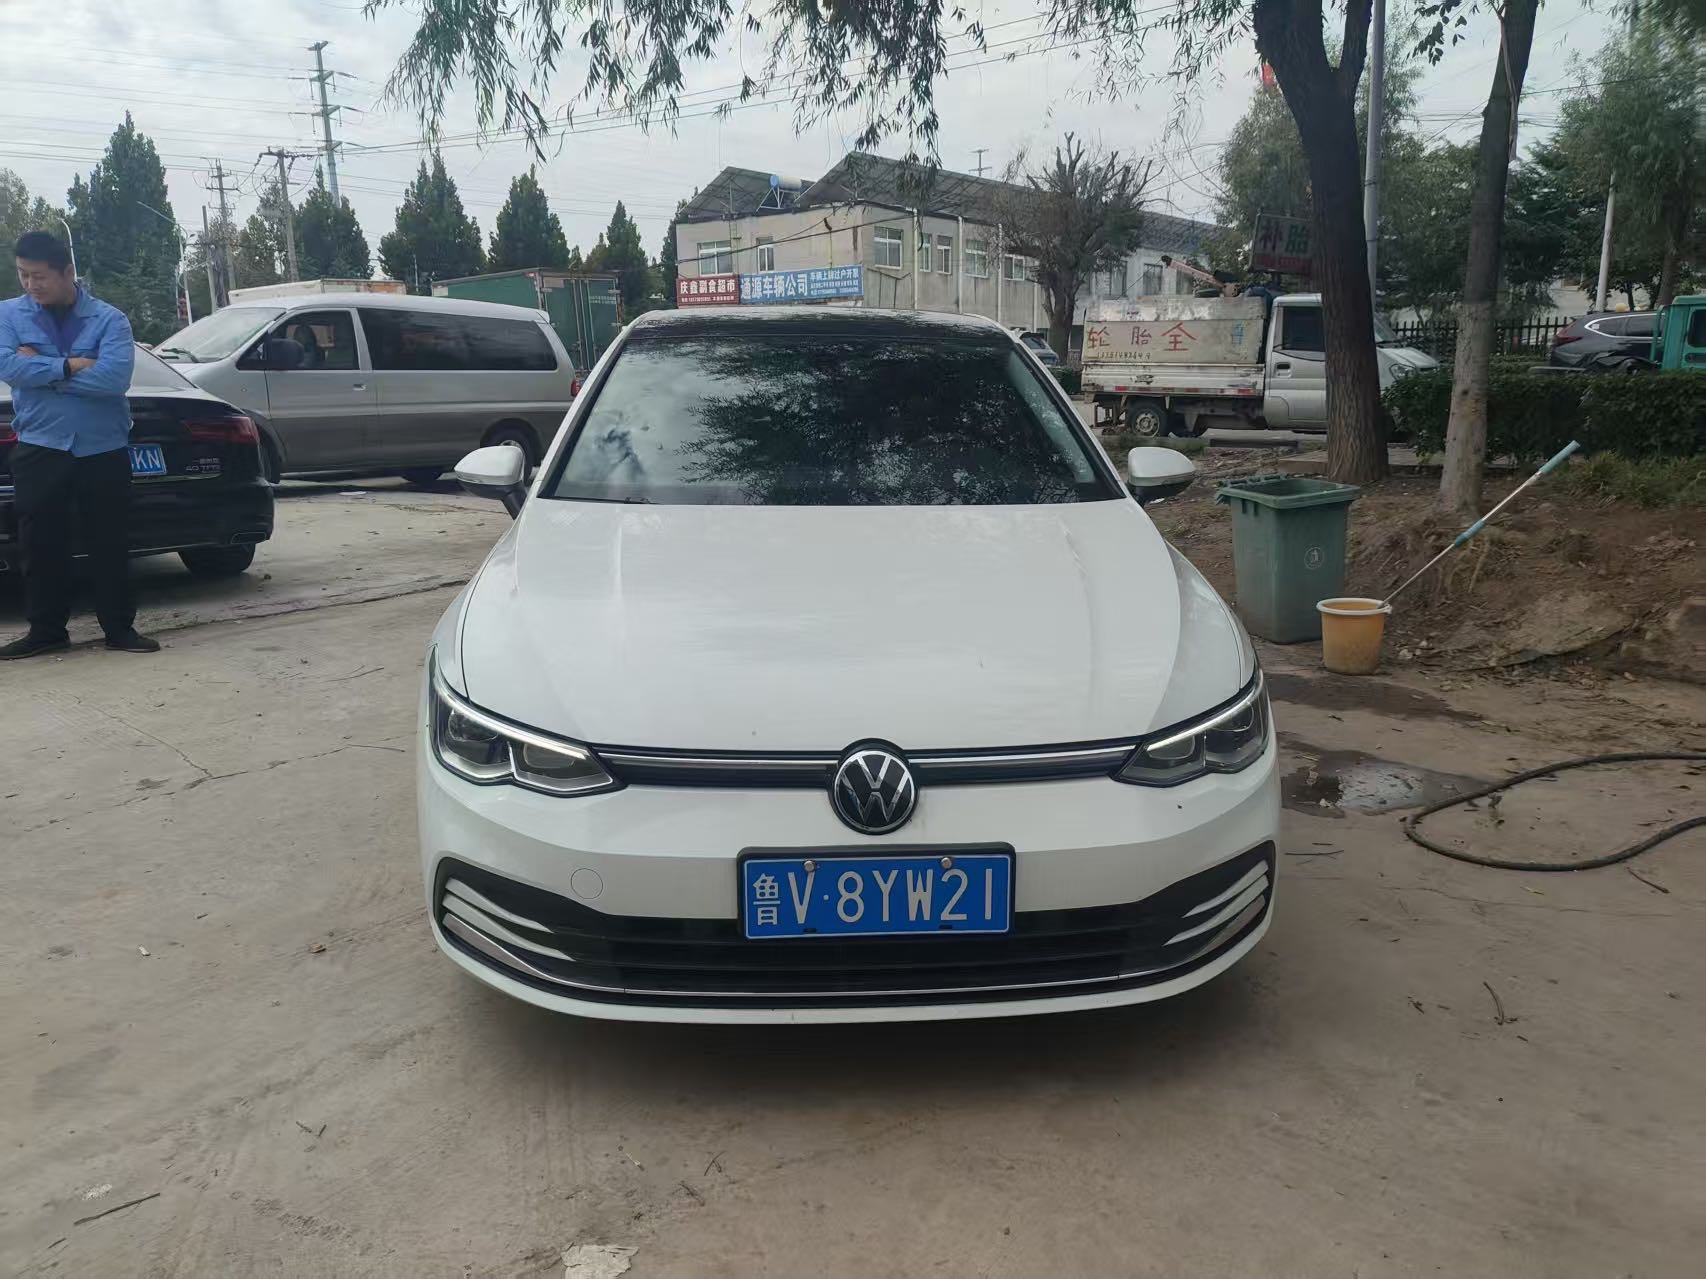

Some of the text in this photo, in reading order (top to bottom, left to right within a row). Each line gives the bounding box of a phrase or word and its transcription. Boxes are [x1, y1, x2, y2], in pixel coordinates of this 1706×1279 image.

[680, 279, 735, 294] 庆鑫副食超市
[740, 274, 808, 299] 通源车辆公司
